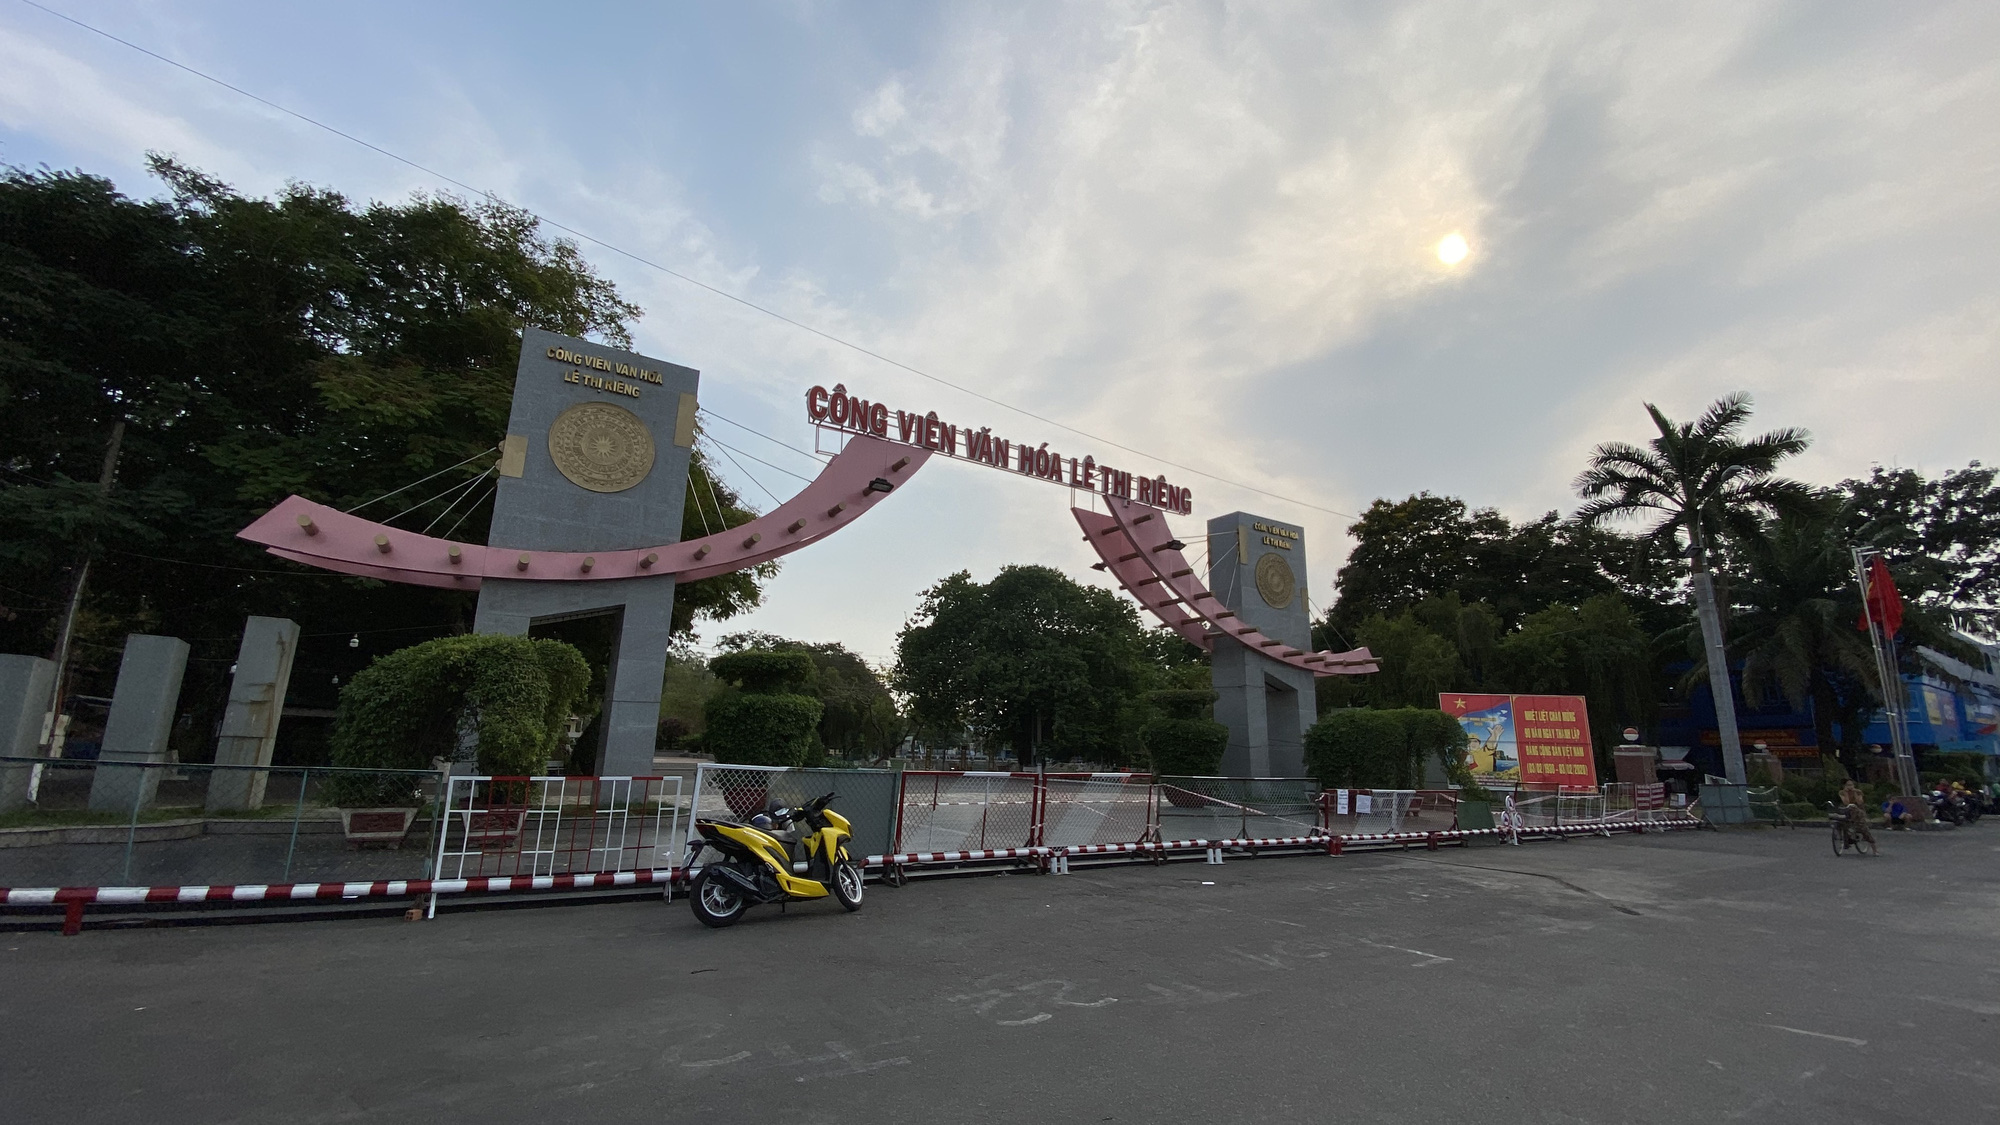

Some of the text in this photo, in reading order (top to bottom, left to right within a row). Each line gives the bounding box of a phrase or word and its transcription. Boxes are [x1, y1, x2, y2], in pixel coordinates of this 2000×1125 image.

[547, 346, 582, 366] CÔNG
[585, 354, 611, 372] VIÊN
[564, 369, 640, 398] LÊ THỊ RIÊNG
[806, 382, 1192, 514] CÔNG VIÊN VĂN HÓA LÊ THỊ RIÊNG
